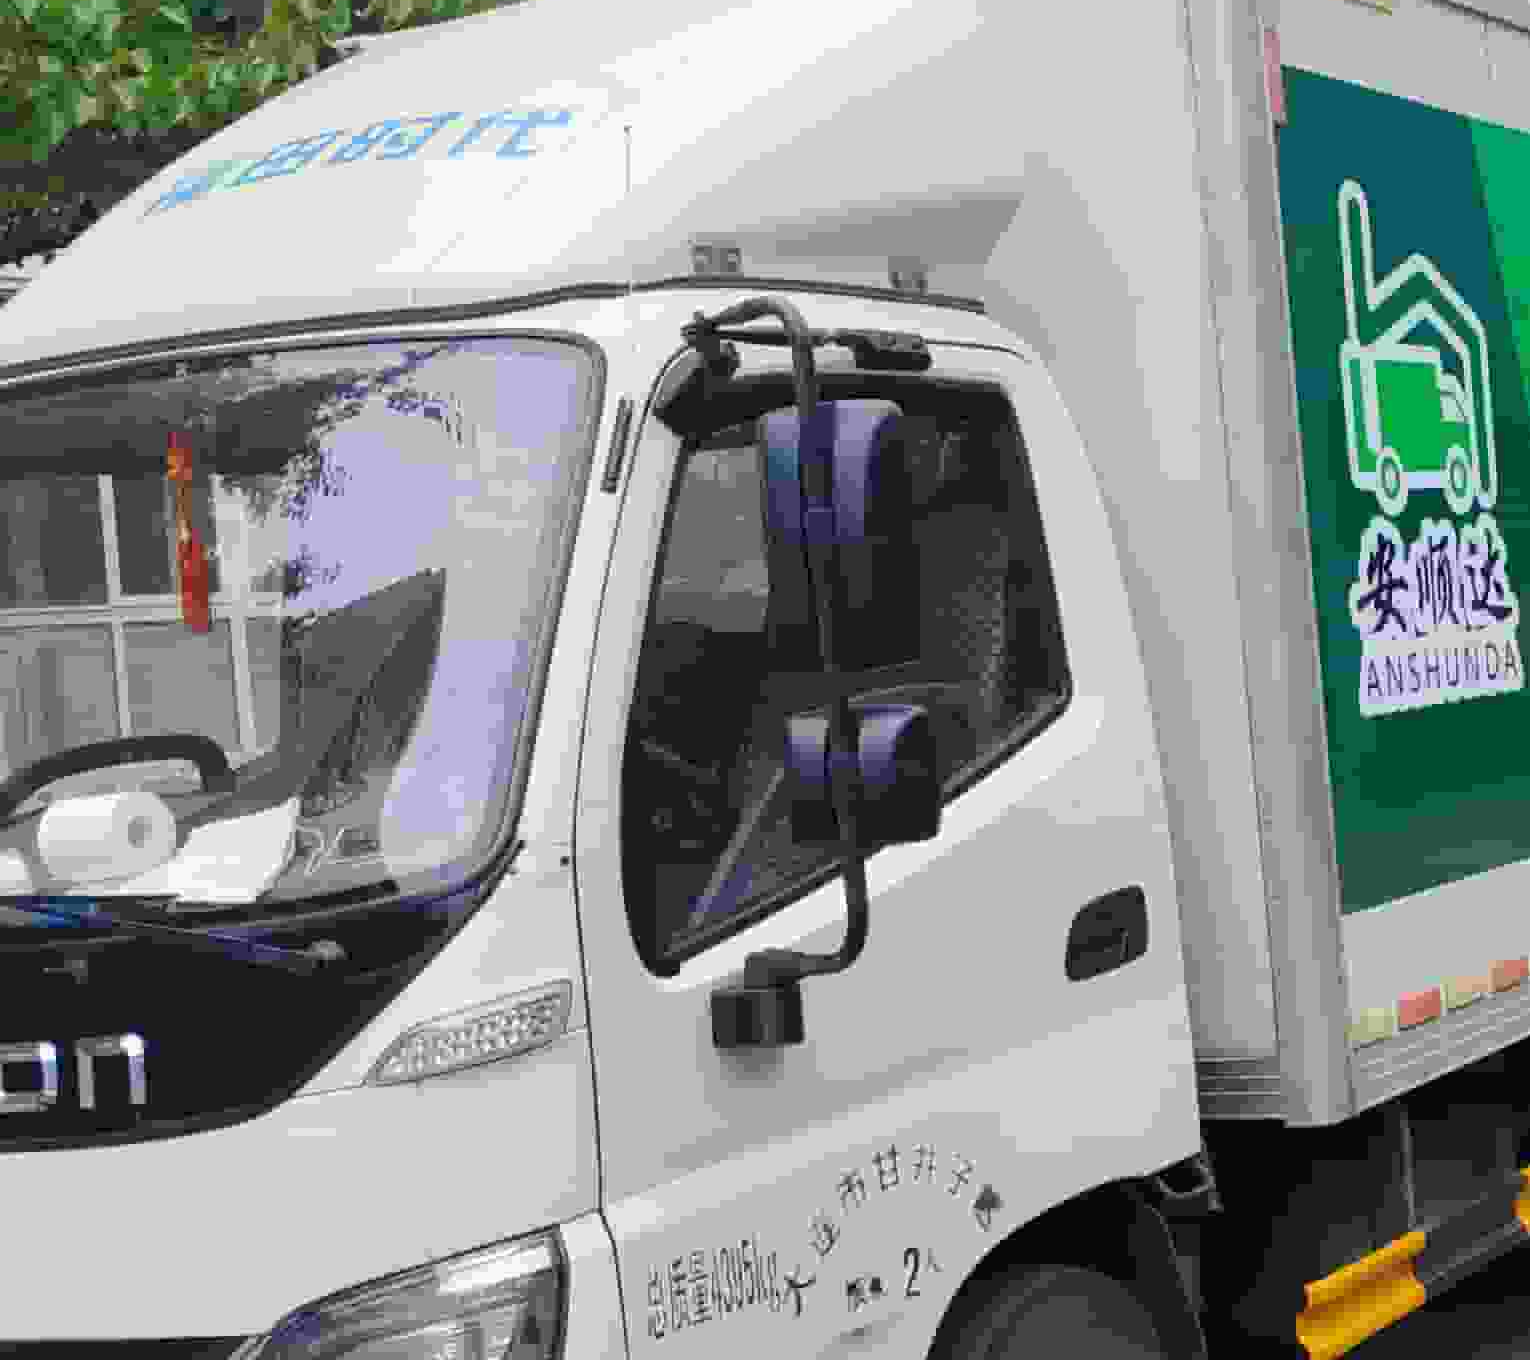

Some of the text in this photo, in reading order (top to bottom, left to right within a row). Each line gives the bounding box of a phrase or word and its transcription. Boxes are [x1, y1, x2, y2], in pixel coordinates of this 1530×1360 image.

[1359, 530, 1513, 635] 安顺达
[1367, 640, 1519, 698] ANSHUNDA
